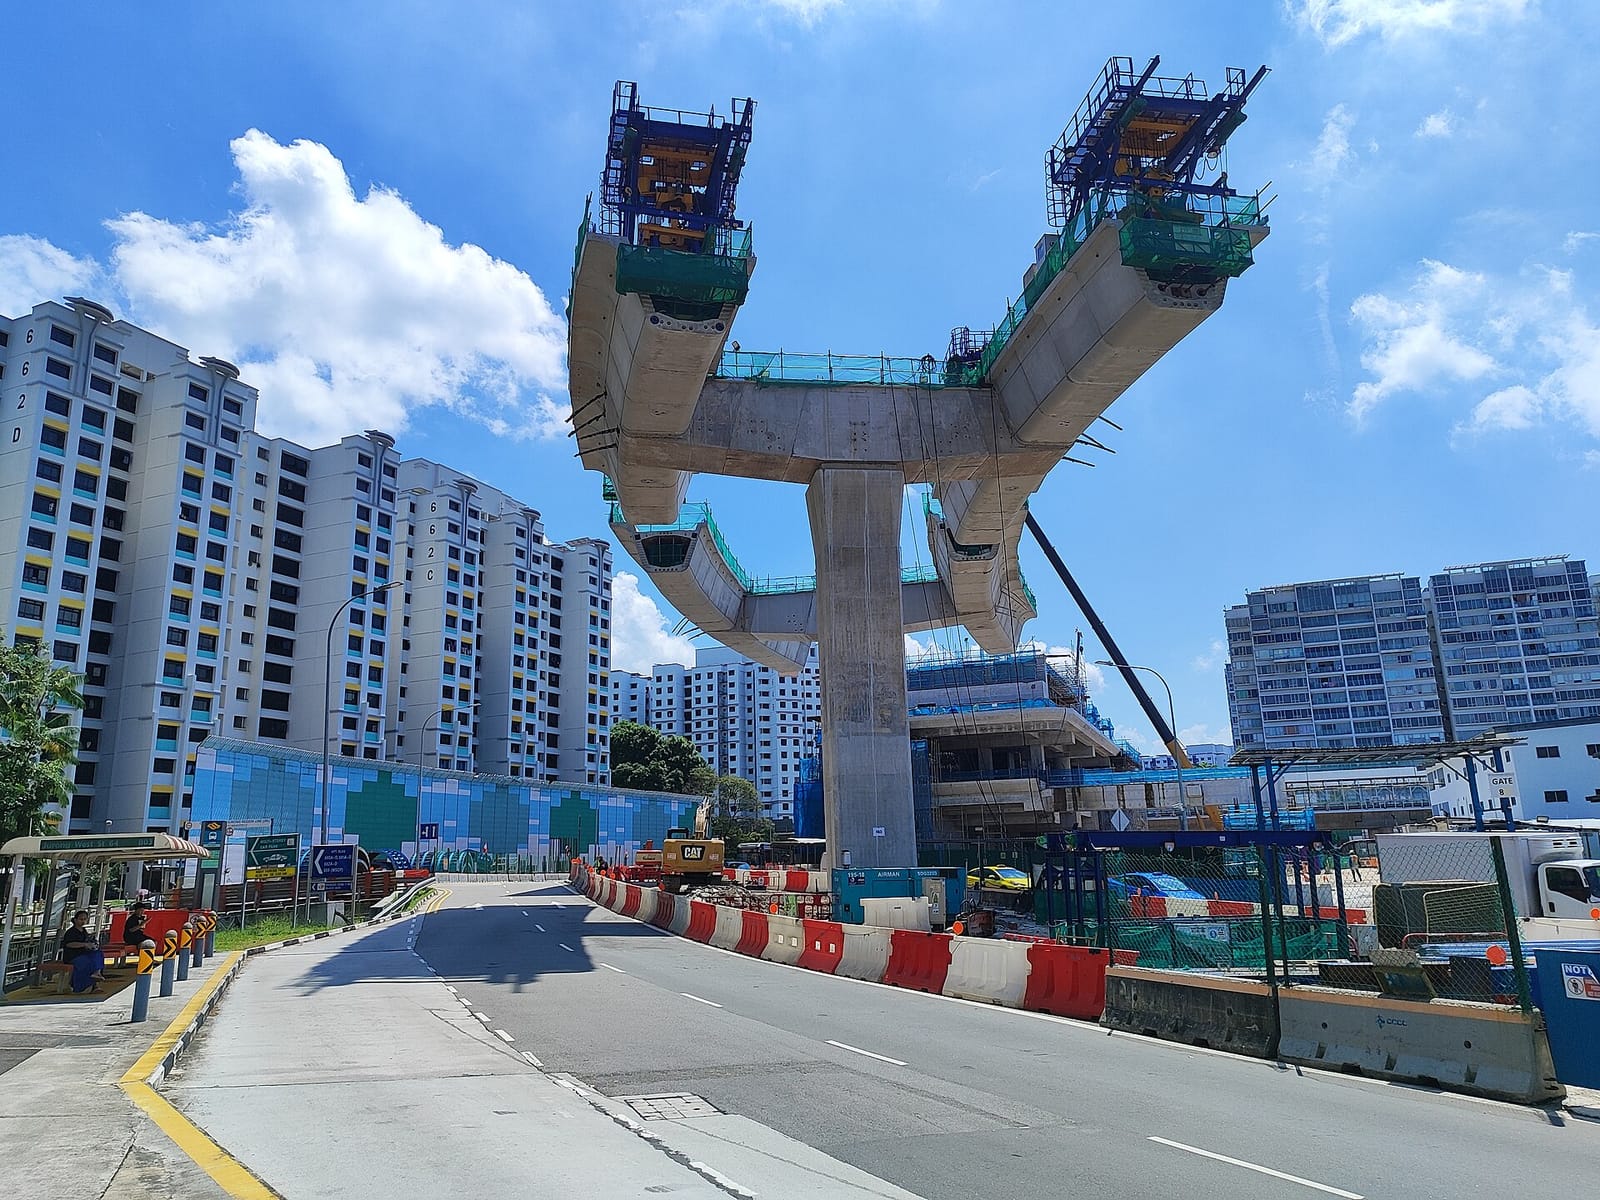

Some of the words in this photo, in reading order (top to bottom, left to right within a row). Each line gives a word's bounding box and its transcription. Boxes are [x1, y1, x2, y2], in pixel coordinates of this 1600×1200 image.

[1492, 777, 1513, 785] GATE
[74, 839, 94, 848] West
[684, 847, 702, 858] CAT
